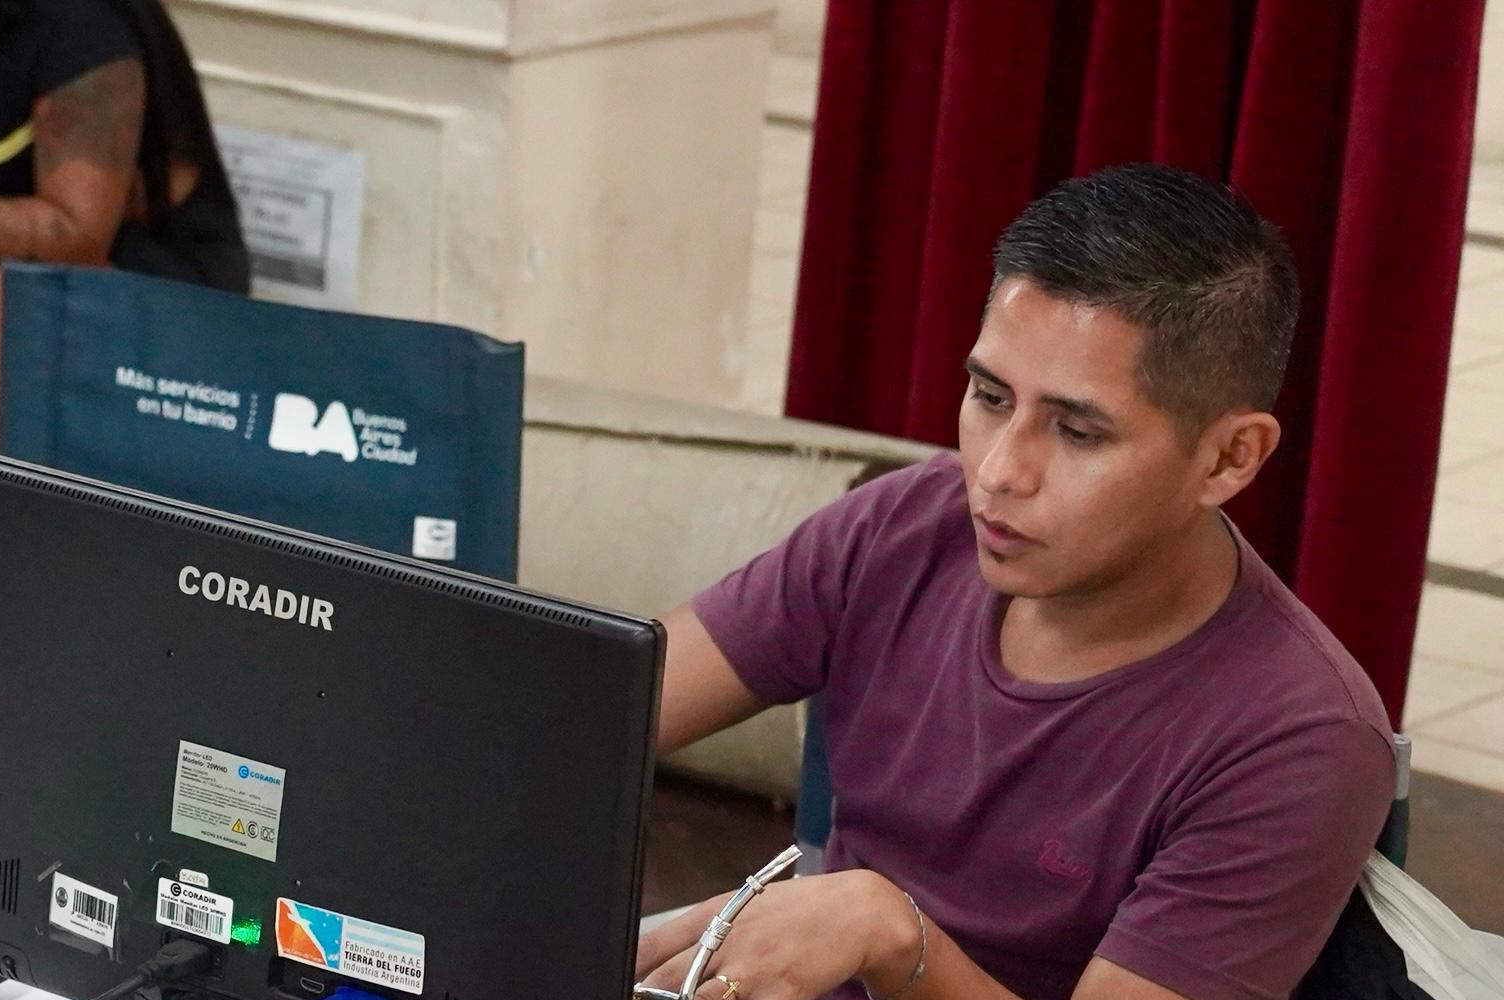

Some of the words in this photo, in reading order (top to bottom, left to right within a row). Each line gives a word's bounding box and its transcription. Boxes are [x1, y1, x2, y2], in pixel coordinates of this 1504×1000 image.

[156, 378, 240, 408] servicios
[137, 397, 161, 415] en
[162, 400, 182, 420] tu
[183, 401, 237, 431] barrio
[268, 392, 359, 463] BA
[352, 407, 407, 432] Buenos
[360, 427, 401, 448] Aires
[362, 441, 417, 466] Ciudad
[178, 565, 334, 631] CORADIR
[345, 940, 385, 959] Fabricado
[388, 953, 398, 963] en
[345, 951, 373, 967] TIERRA
[376, 960, 391, 972] DEL
[394, 964, 422, 979] FUEGO
[343, 961, 379, 978] Industria
[380, 970, 420, 989] Argentina
